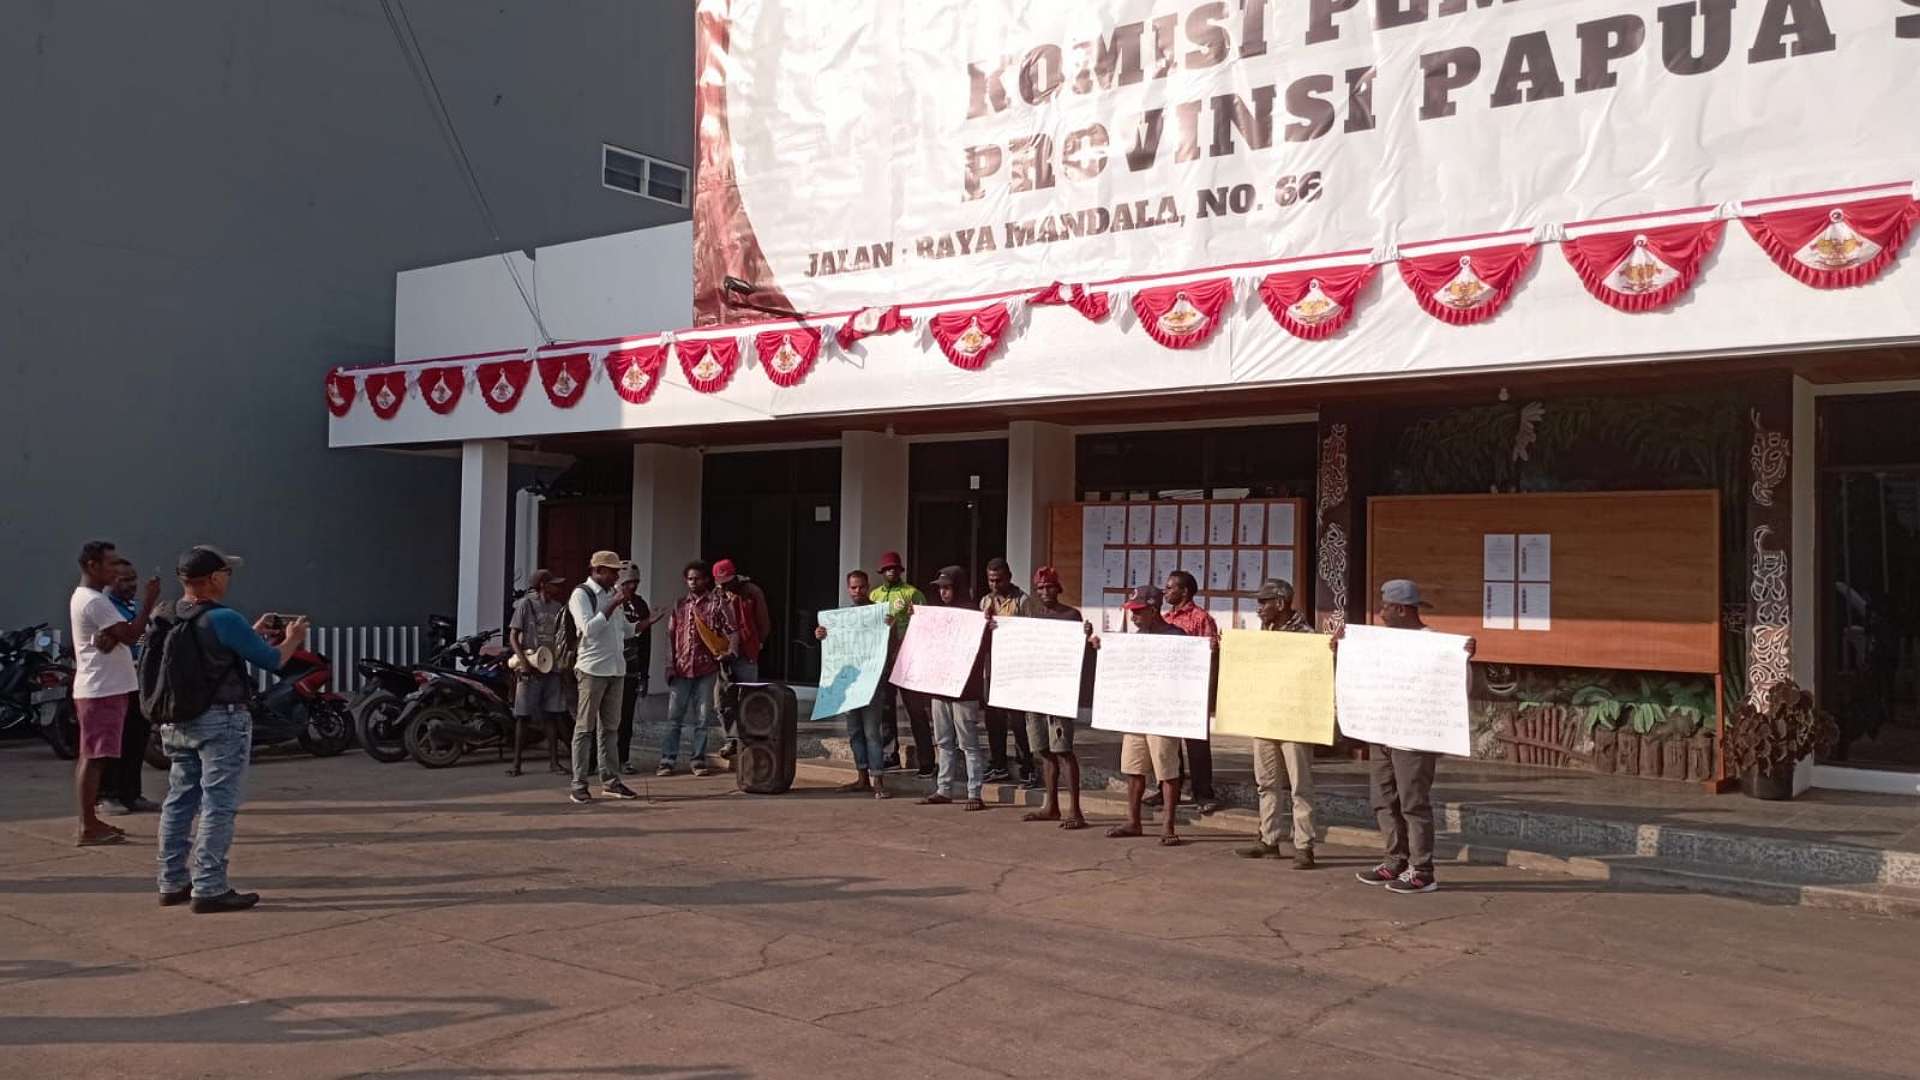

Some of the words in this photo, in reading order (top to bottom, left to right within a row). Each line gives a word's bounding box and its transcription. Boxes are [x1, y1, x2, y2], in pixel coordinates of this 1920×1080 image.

[962, 66, 1376, 202] PROVINSI
[1418, 0, 1836, 121] PAPUA
[966, 0, 1268, 120] KOMISI
[804, 240, 894, 278] JALAN
[916, 225, 997, 261] RAYA
[1005, 196, 1187, 249] MANDALA,
[1197, 183, 1264, 219] NO.
[1275, 171, 1323, 208] 66
